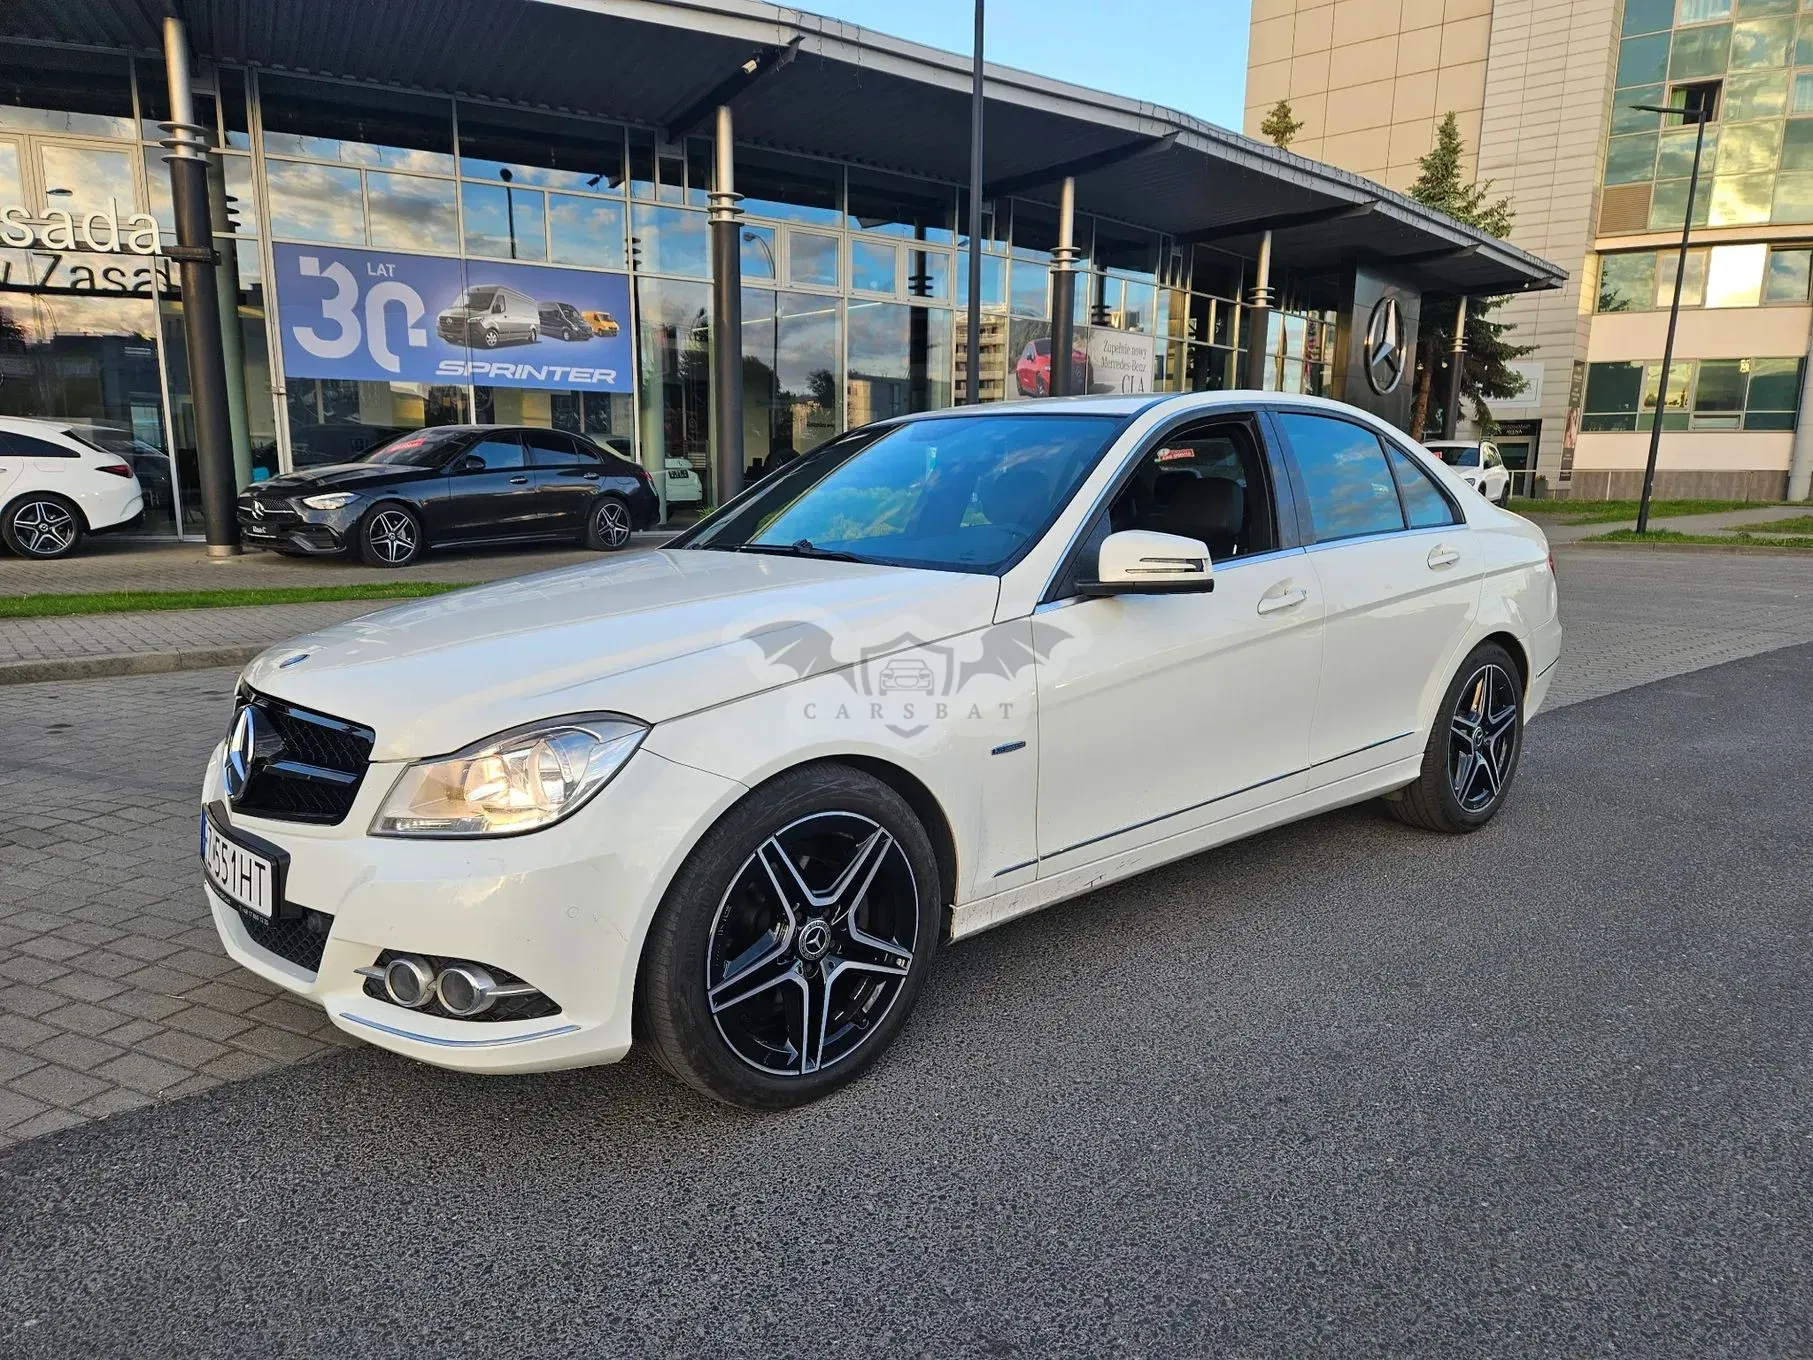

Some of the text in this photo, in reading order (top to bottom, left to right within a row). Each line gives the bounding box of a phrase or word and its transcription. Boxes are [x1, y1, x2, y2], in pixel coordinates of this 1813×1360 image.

[366, 262, 396, 278] LAT
[293, 256, 428, 373] 30
[435, 360, 617, 384] SPRINTER
